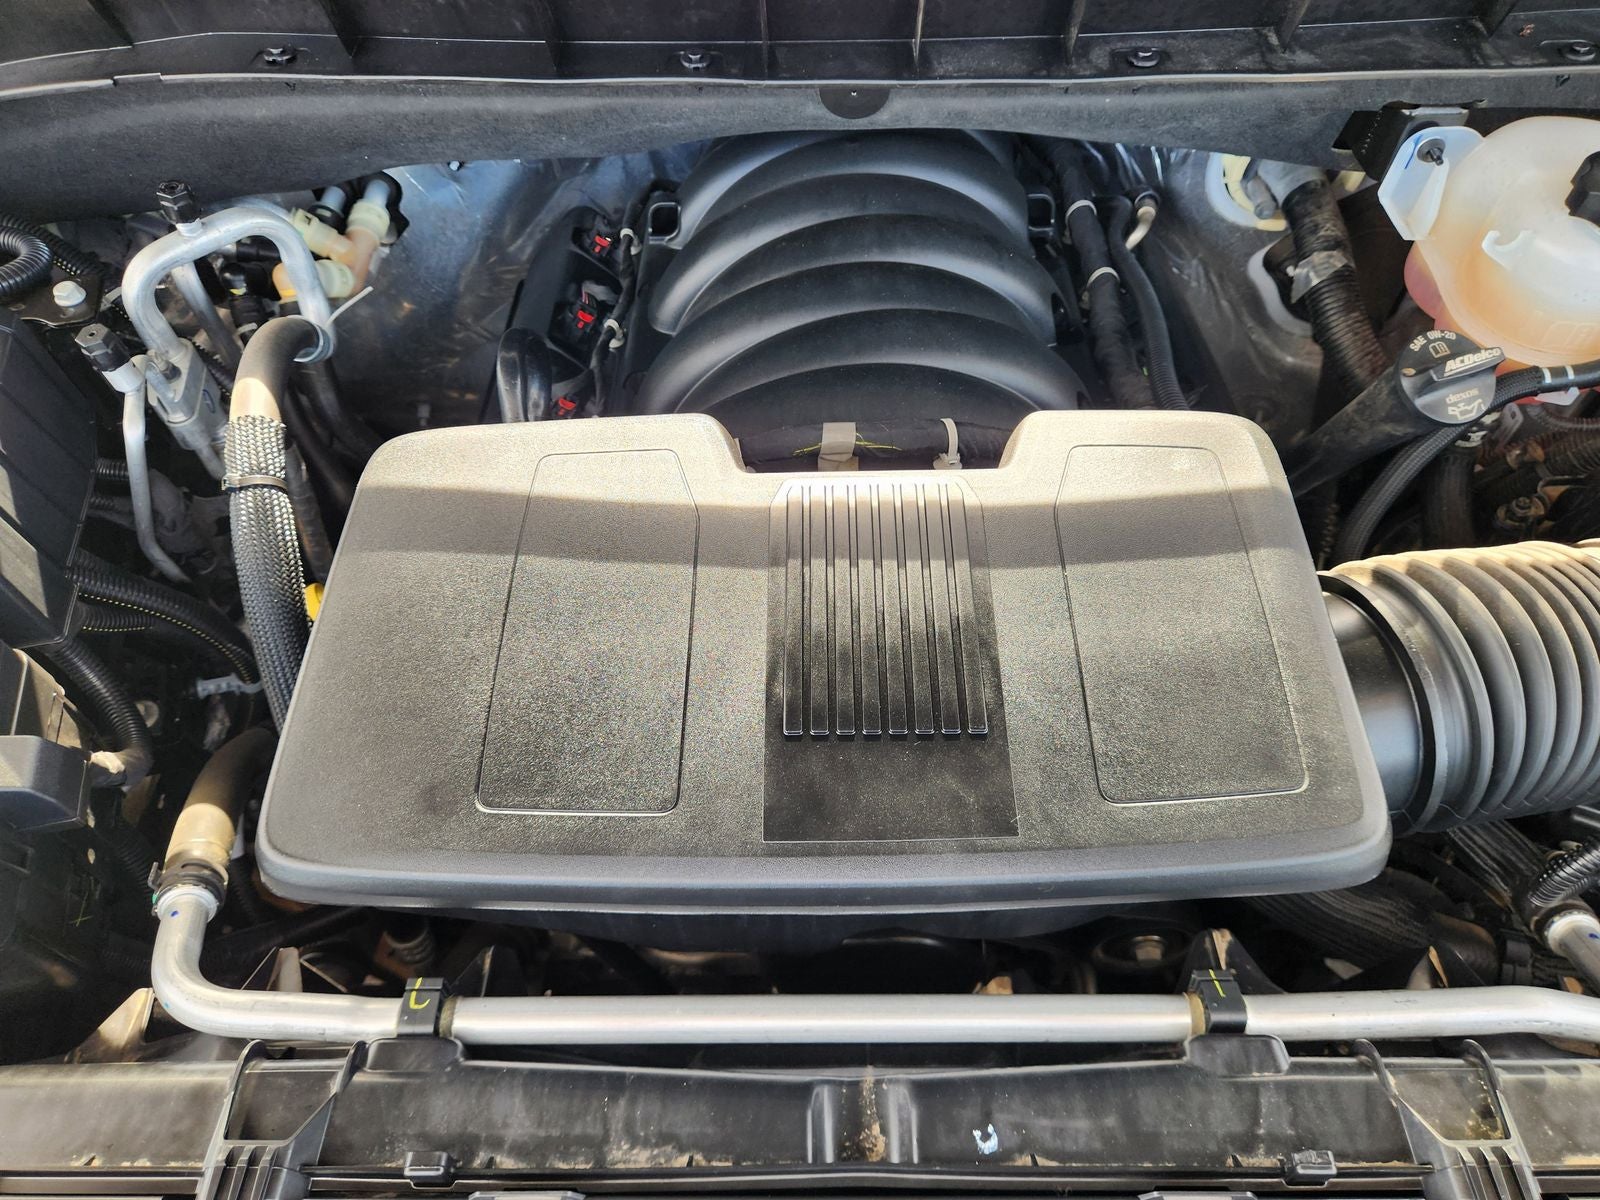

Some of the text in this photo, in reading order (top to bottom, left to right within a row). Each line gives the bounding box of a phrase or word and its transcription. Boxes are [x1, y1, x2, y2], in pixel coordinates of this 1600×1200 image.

[1409, 330, 1457, 352] SAE 0W-20
[1444, 348, 1501, 374] ACDelco
[1445, 388, 1479, 404] dexos
